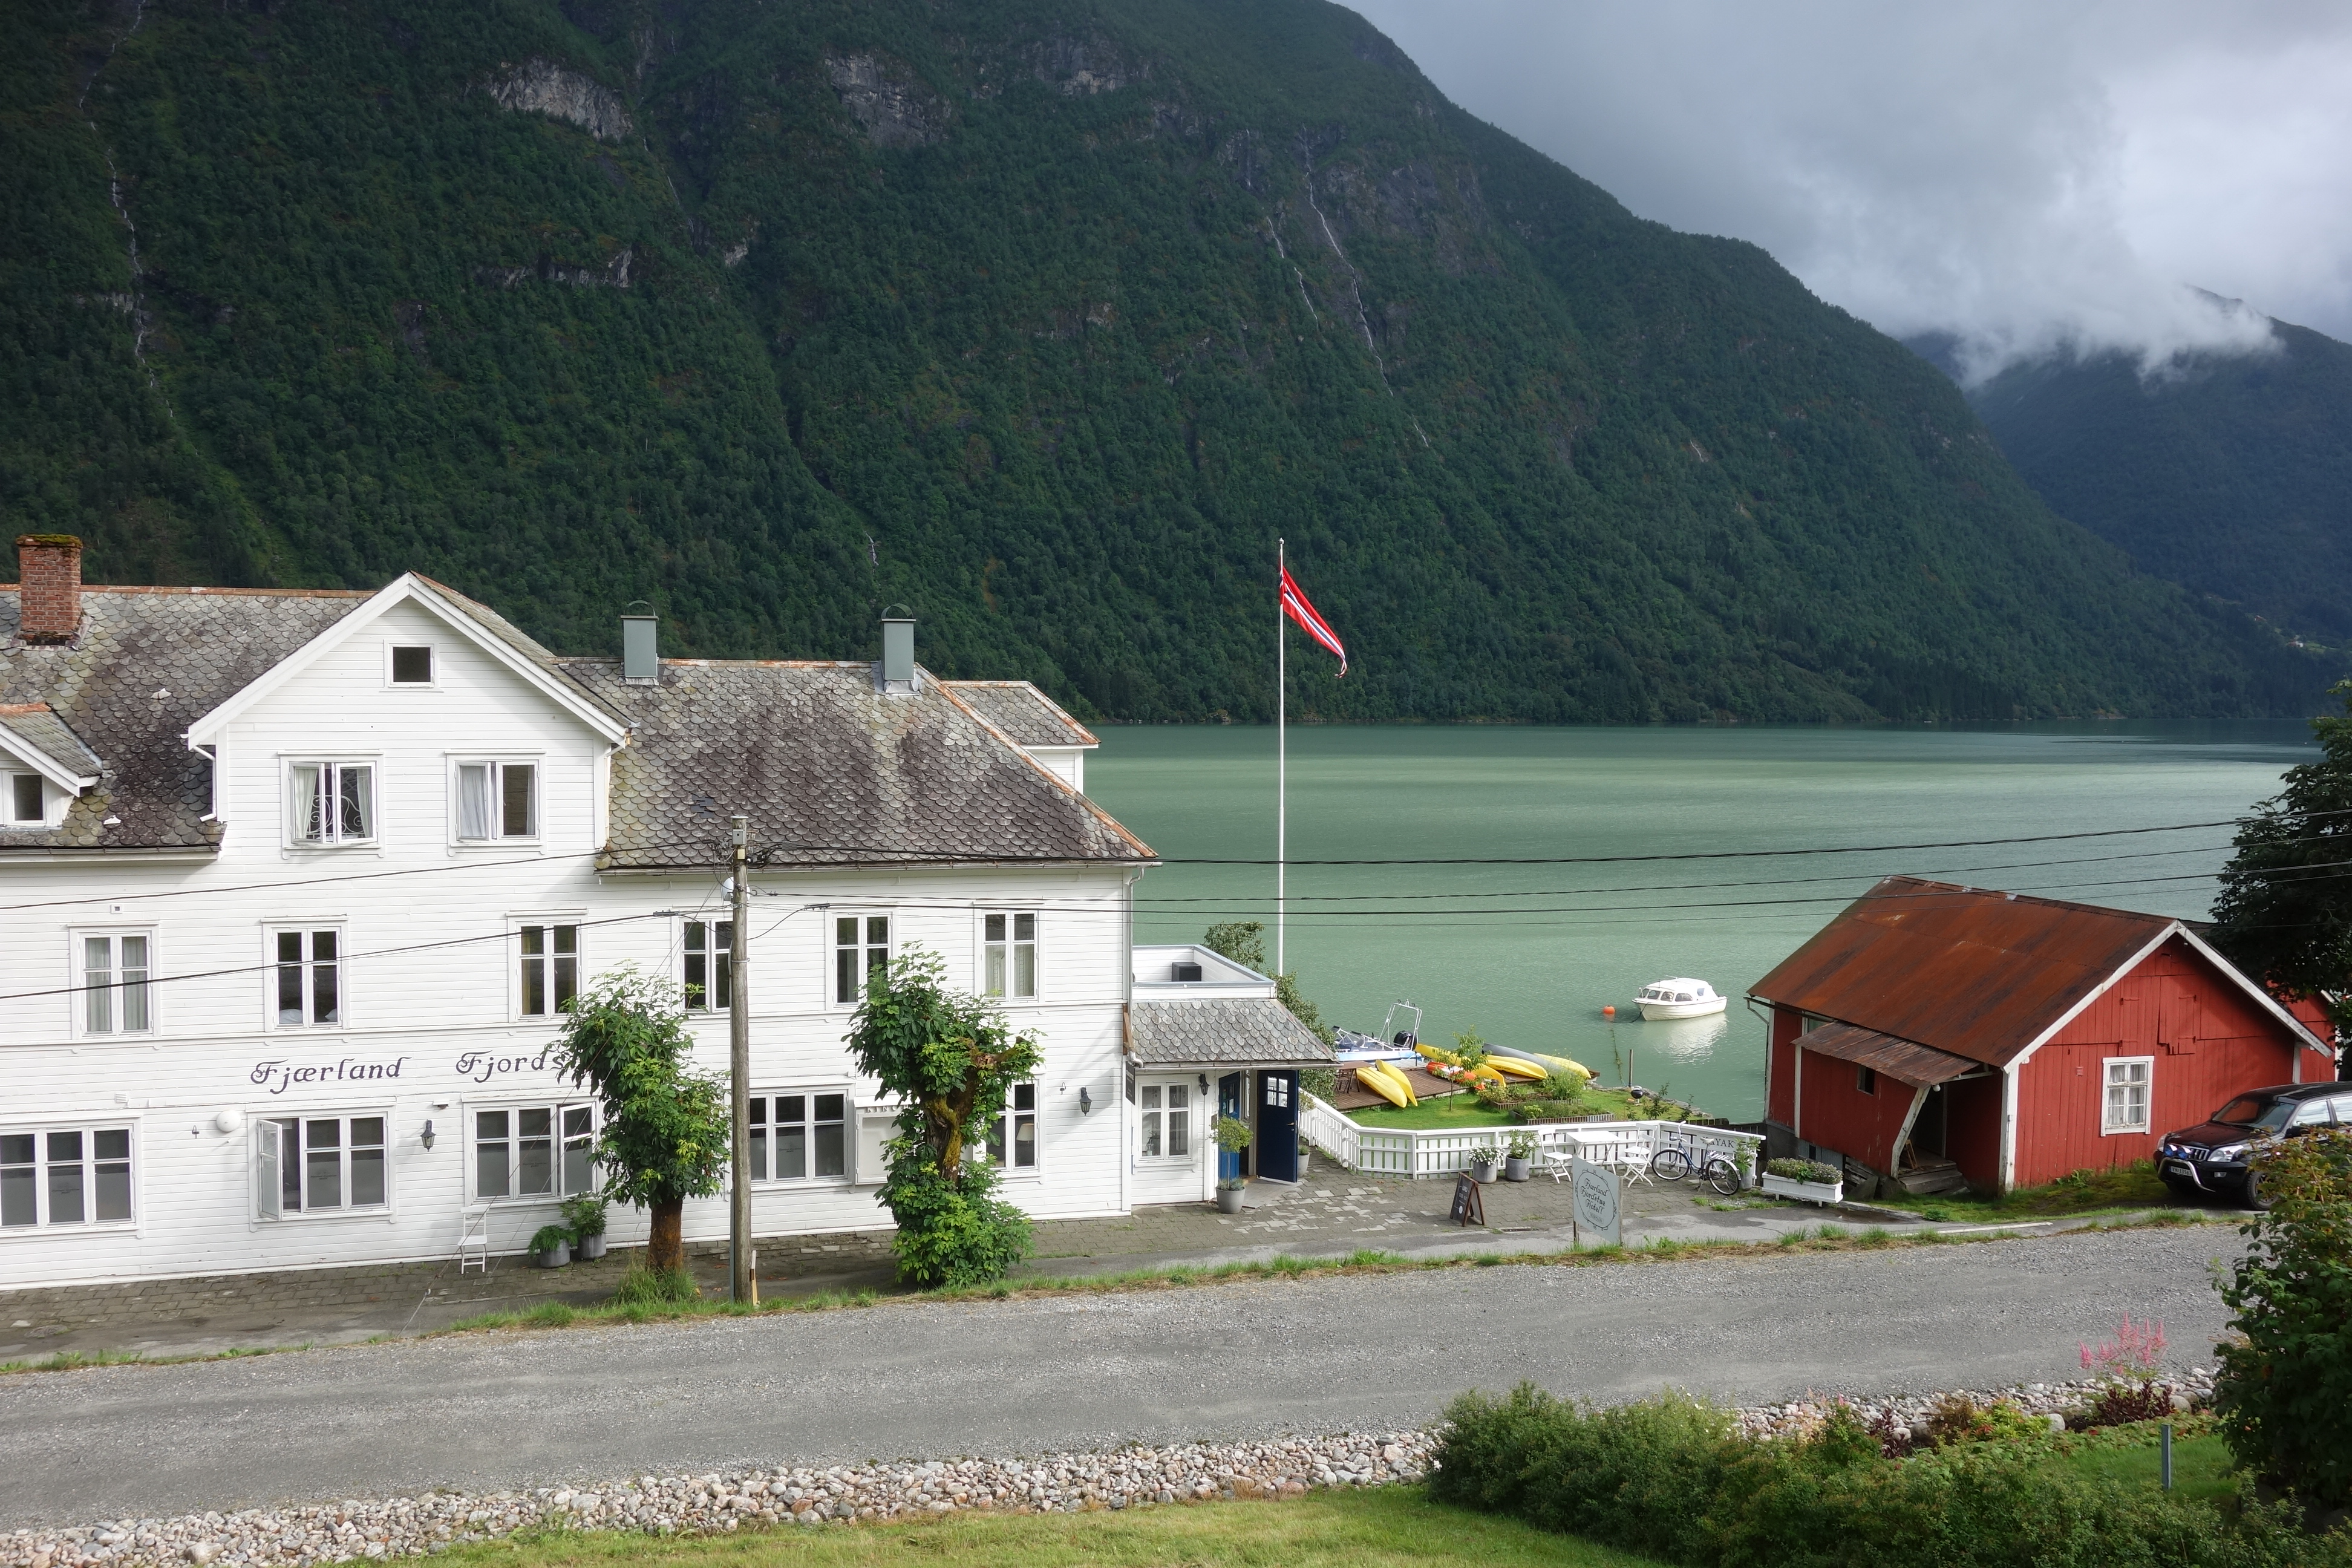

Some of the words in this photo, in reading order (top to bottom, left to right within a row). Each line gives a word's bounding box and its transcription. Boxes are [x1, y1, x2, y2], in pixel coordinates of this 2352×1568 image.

[250, 1056, 413, 1095] Fjærland
[1580, 1186, 1606, 1206] Fjordstue
[1584, 1178, 1609, 1197] Fjærland
[1585, 1198, 1605, 1215] Hotell
